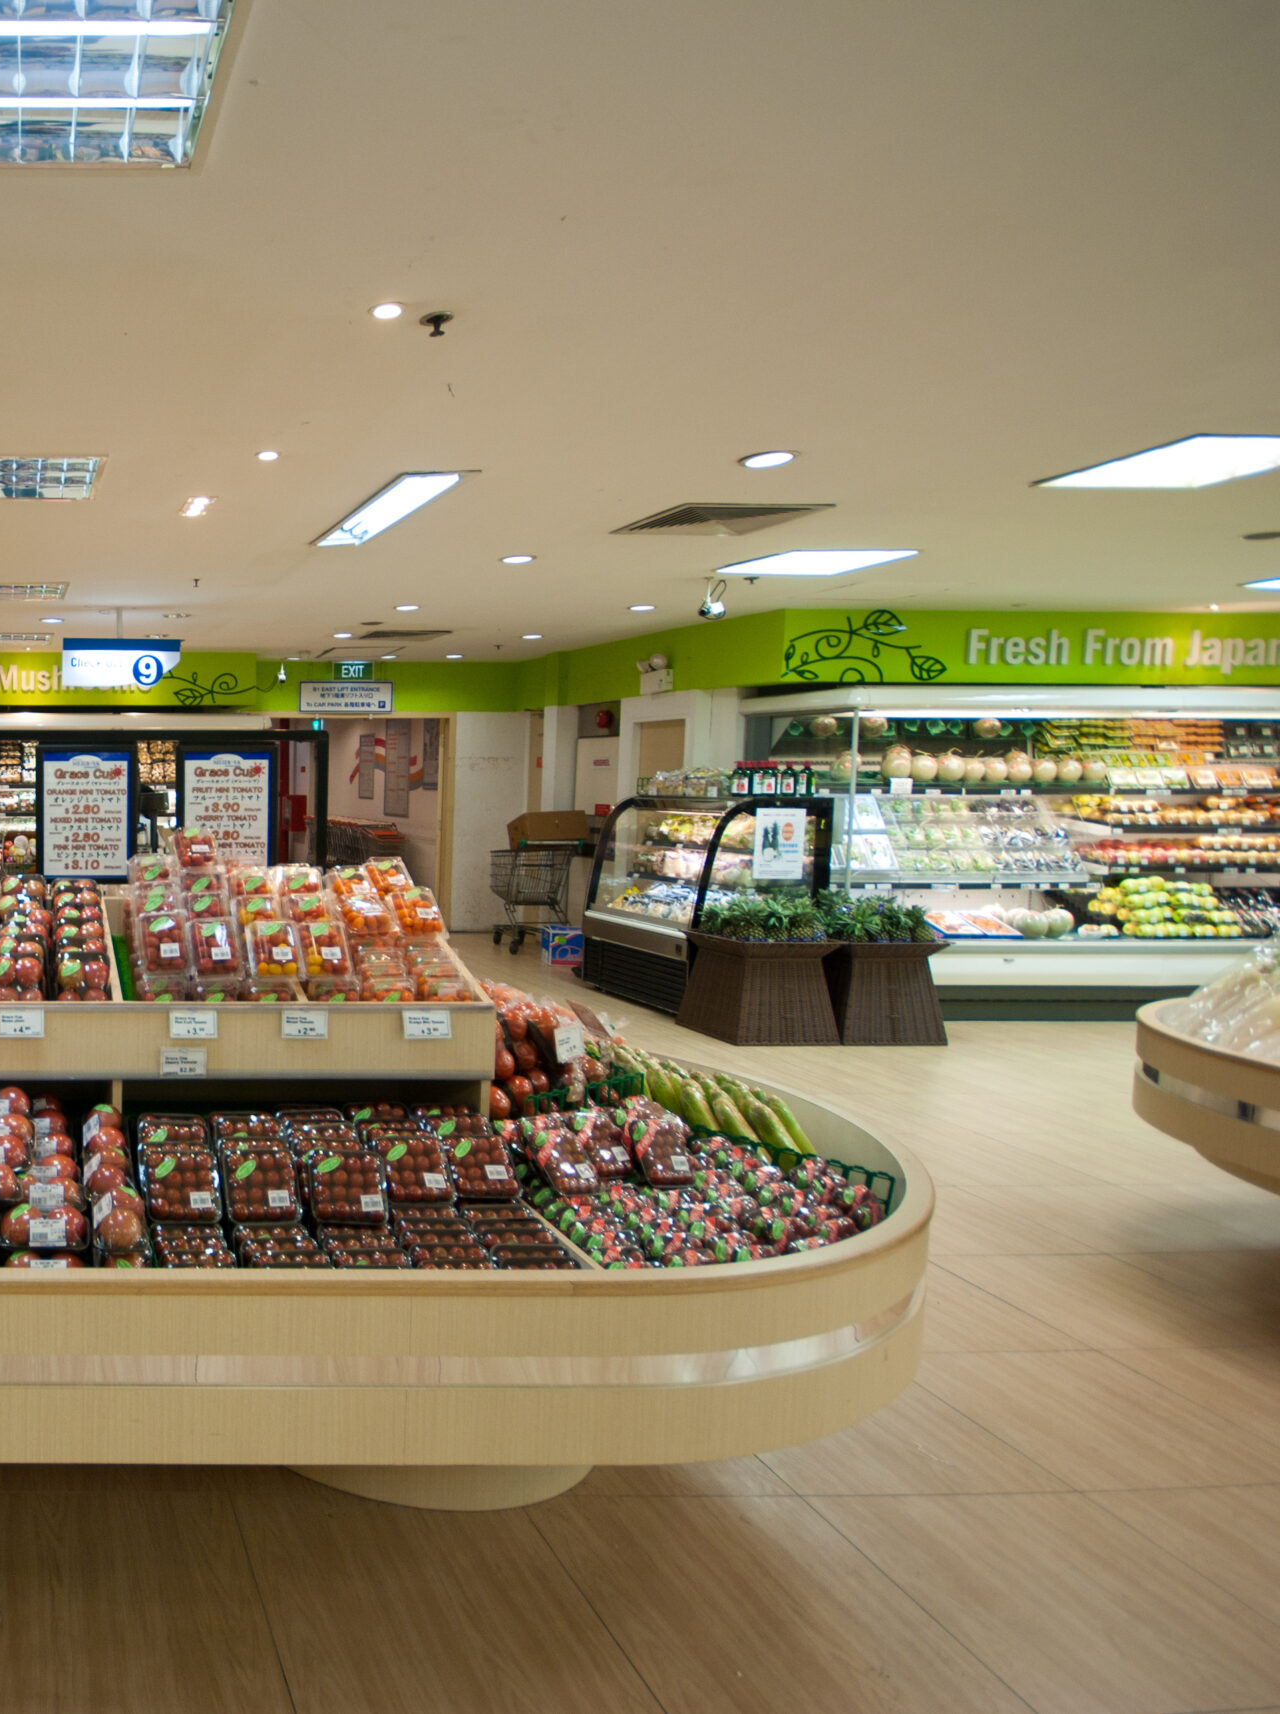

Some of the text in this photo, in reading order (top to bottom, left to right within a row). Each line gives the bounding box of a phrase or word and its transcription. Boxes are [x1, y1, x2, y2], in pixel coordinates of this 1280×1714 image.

[967, 629, 1069, 665] Fresh
[1083, 629, 1174, 665] From
[139, 657, 158, 684] 9
[341, 665, 365, 678] EXIT
[54, 768, 116, 781] Grace Cup
[194, 766, 257, 779] Grace Cup
